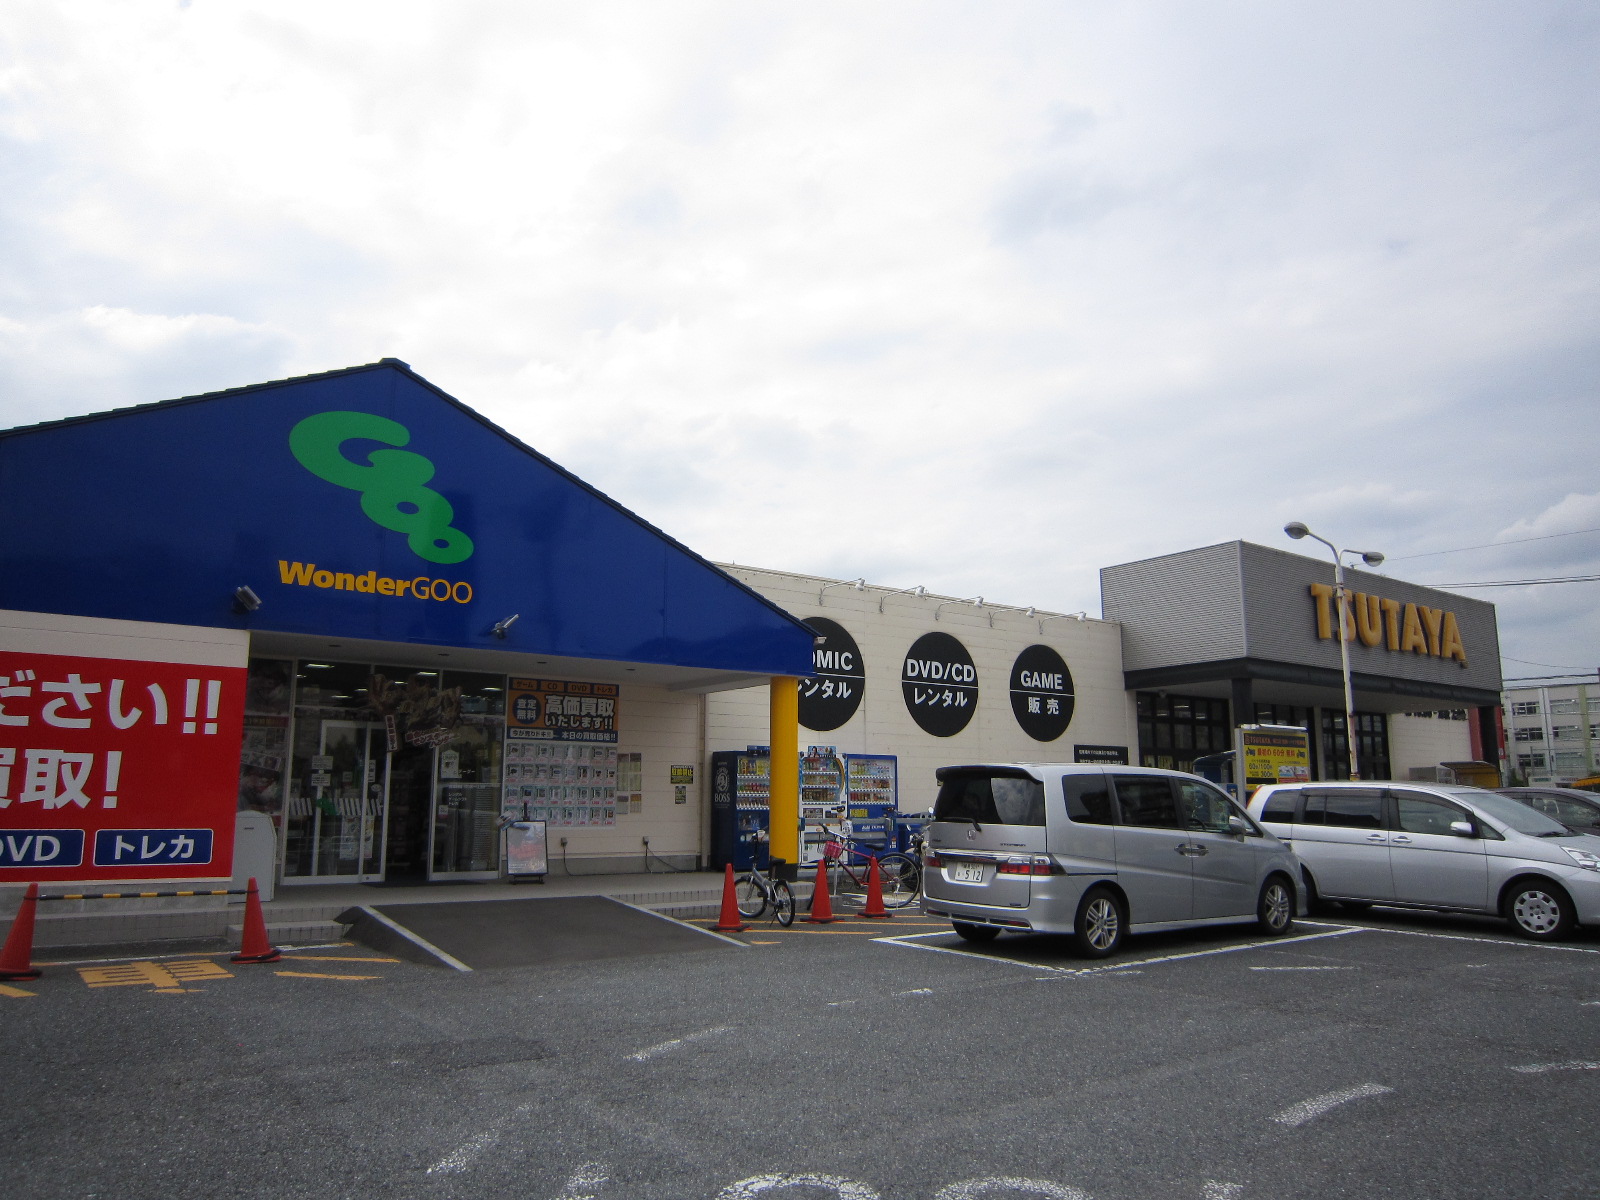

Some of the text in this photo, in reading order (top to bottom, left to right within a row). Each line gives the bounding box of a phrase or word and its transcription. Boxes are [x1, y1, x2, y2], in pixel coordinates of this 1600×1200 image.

[279, 559, 474, 604] WonderGOO
[1310, 583, 1466, 661] TSUTAYA
[812, 649, 852, 671] MIC
[906, 658, 976, 682] DVD/CD
[547, 682, 558, 691] CD
[571, 684, 587, 692] DVD
[798, 679, 851, 699] ンタル
[1020, 670, 1063, 690] GAME
[545, 695, 614, 717] 高価買取
[914, 687, 967, 708] レンタル
[1028, 696, 1059, 715] 販売
[0, 747, 122, 810] 取!
[714, 793, 730, 802] BOSS
[0, 835, 61, 862] VD
[114, 834, 195, 860] トレカ
